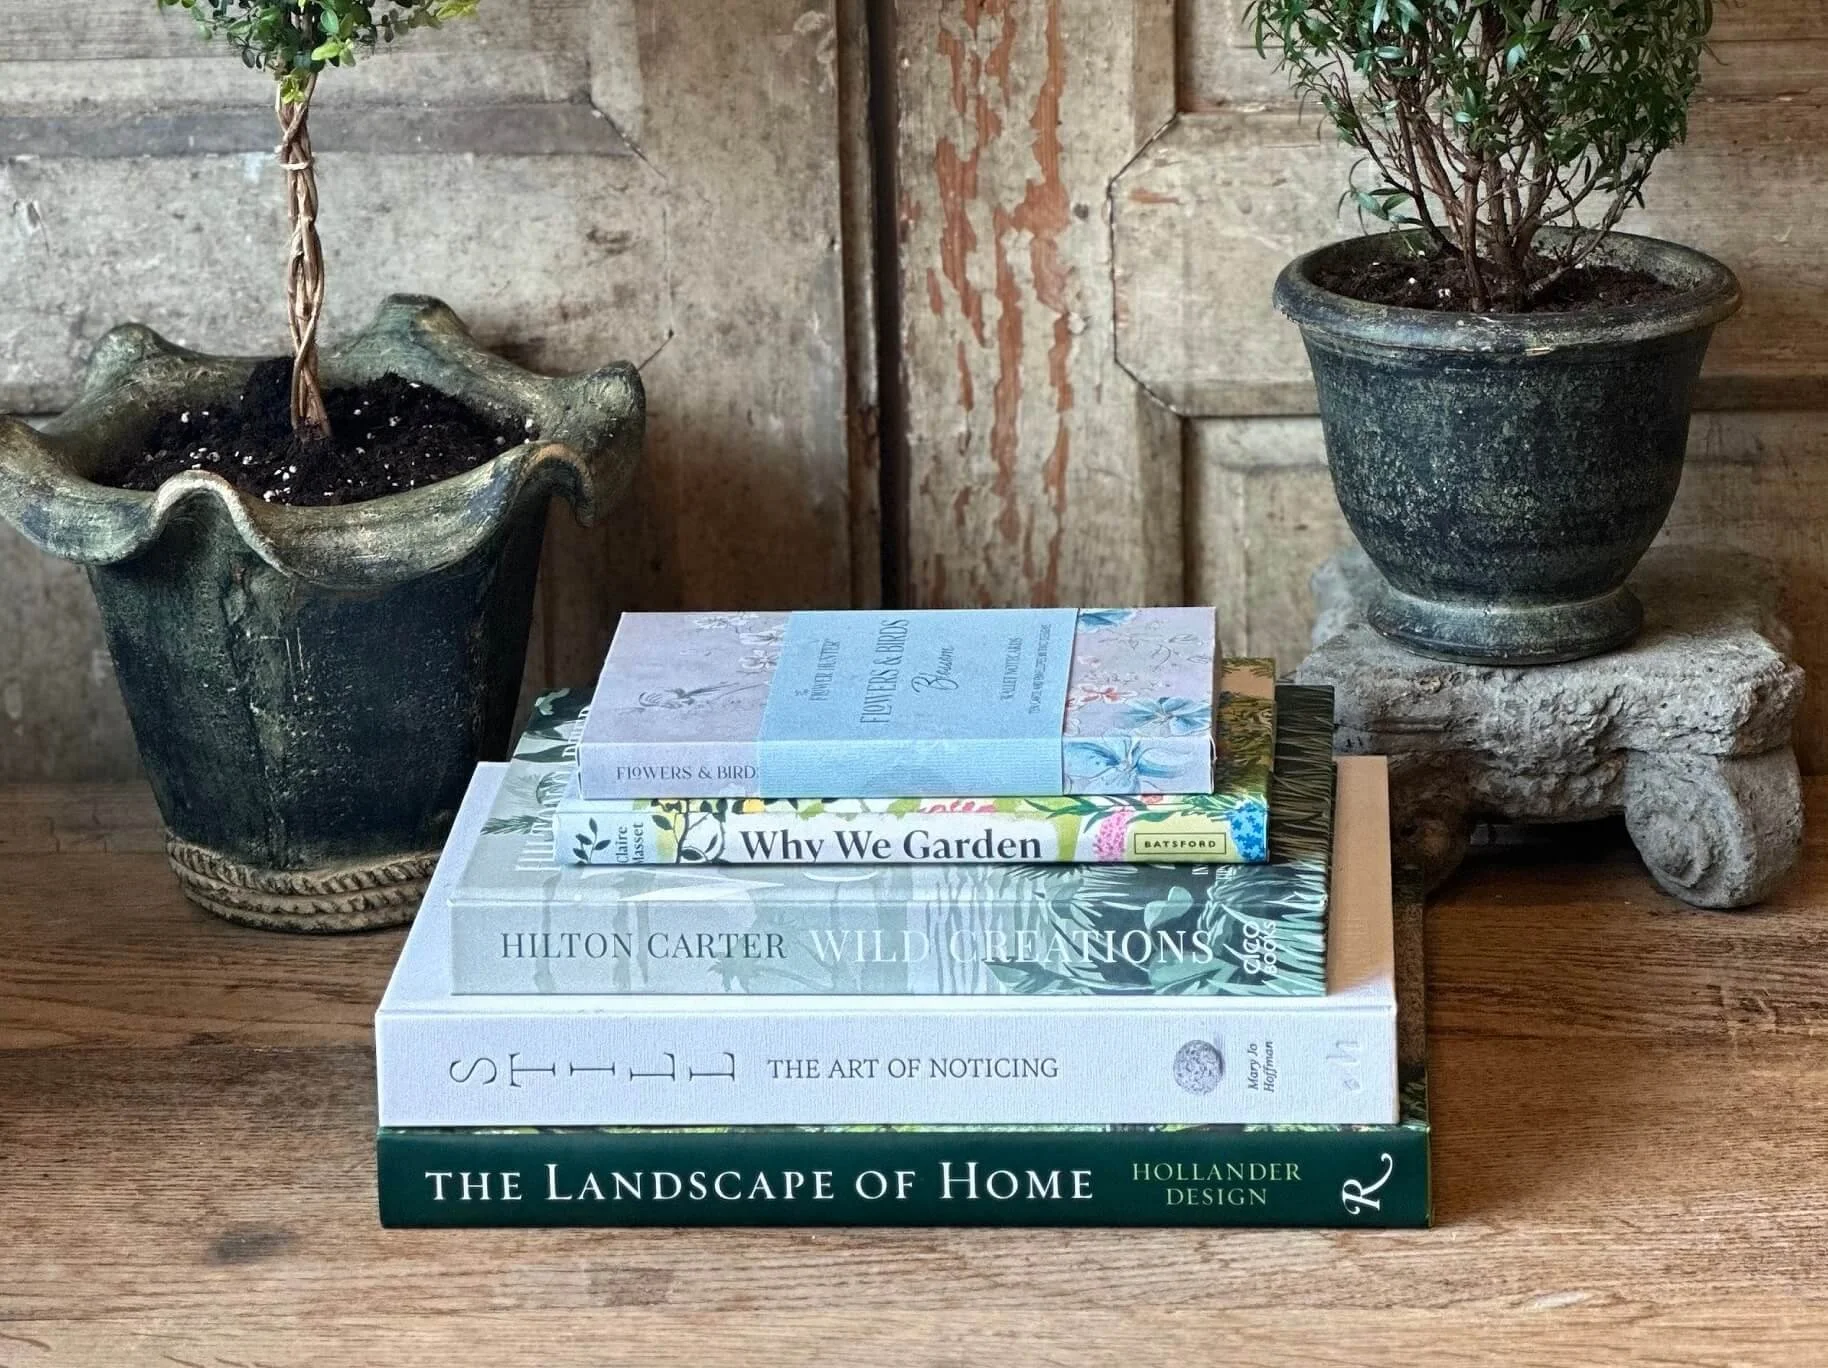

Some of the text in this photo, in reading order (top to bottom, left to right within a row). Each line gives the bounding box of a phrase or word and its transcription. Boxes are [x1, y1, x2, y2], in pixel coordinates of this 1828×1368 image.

[874, 618, 910, 653] BIRDS
[911, 645, 959, 693] Blossom
[859, 669, 900, 723] FLOWERS
[616, 765, 758, 781] FLOWERS & BIRD
[615, 826, 629, 864] Claire
[739, 828, 1043, 862] Why We Garden
[1143, 840, 1217, 849] BATSFORD
[500, 928, 1214, 965] HILTON CARTER WILD CREATIONS
[1263, 920, 1278, 975] BOOKS
[448, 1051, 736, 1088] STILL
[767, 1057, 1060, 1079] THE ART OF NOTICING
[1247, 1043, 1262, 1090] Mary Jo
[1263, 1040, 1278, 1093] Hoffman
[424, 1161, 1094, 1202] THE LANDSCAPE OF HOME
[1131, 1161, 1303, 1182] HOLLANDER
[1166, 1187, 1268, 1206] DESIGN
